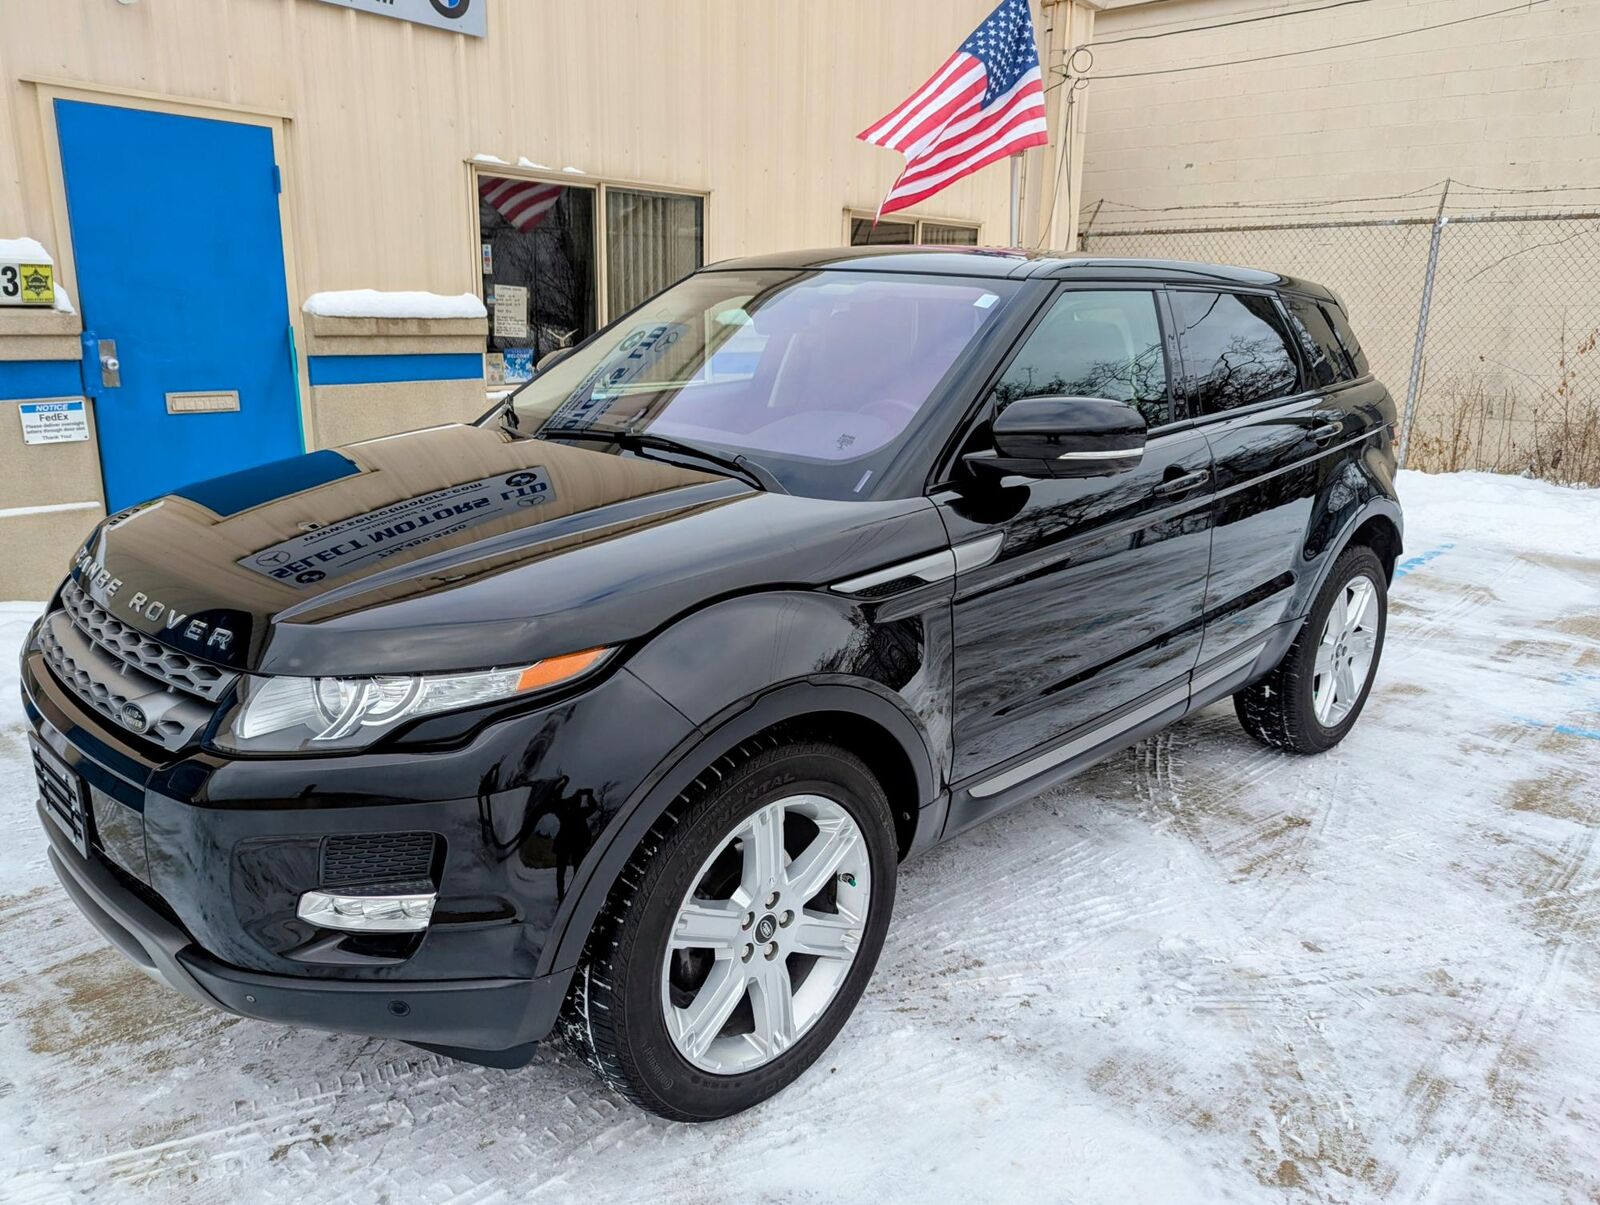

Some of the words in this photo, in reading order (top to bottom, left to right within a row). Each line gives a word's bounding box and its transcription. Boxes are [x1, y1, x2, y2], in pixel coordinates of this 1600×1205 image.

[1, 266, 19, 297] 3
[35, 404, 68, 412] NOTICE
[39, 412, 69, 422] FedEx
[75, 545, 124, 598] RANGE
[127, 591, 235, 651] ROVER
